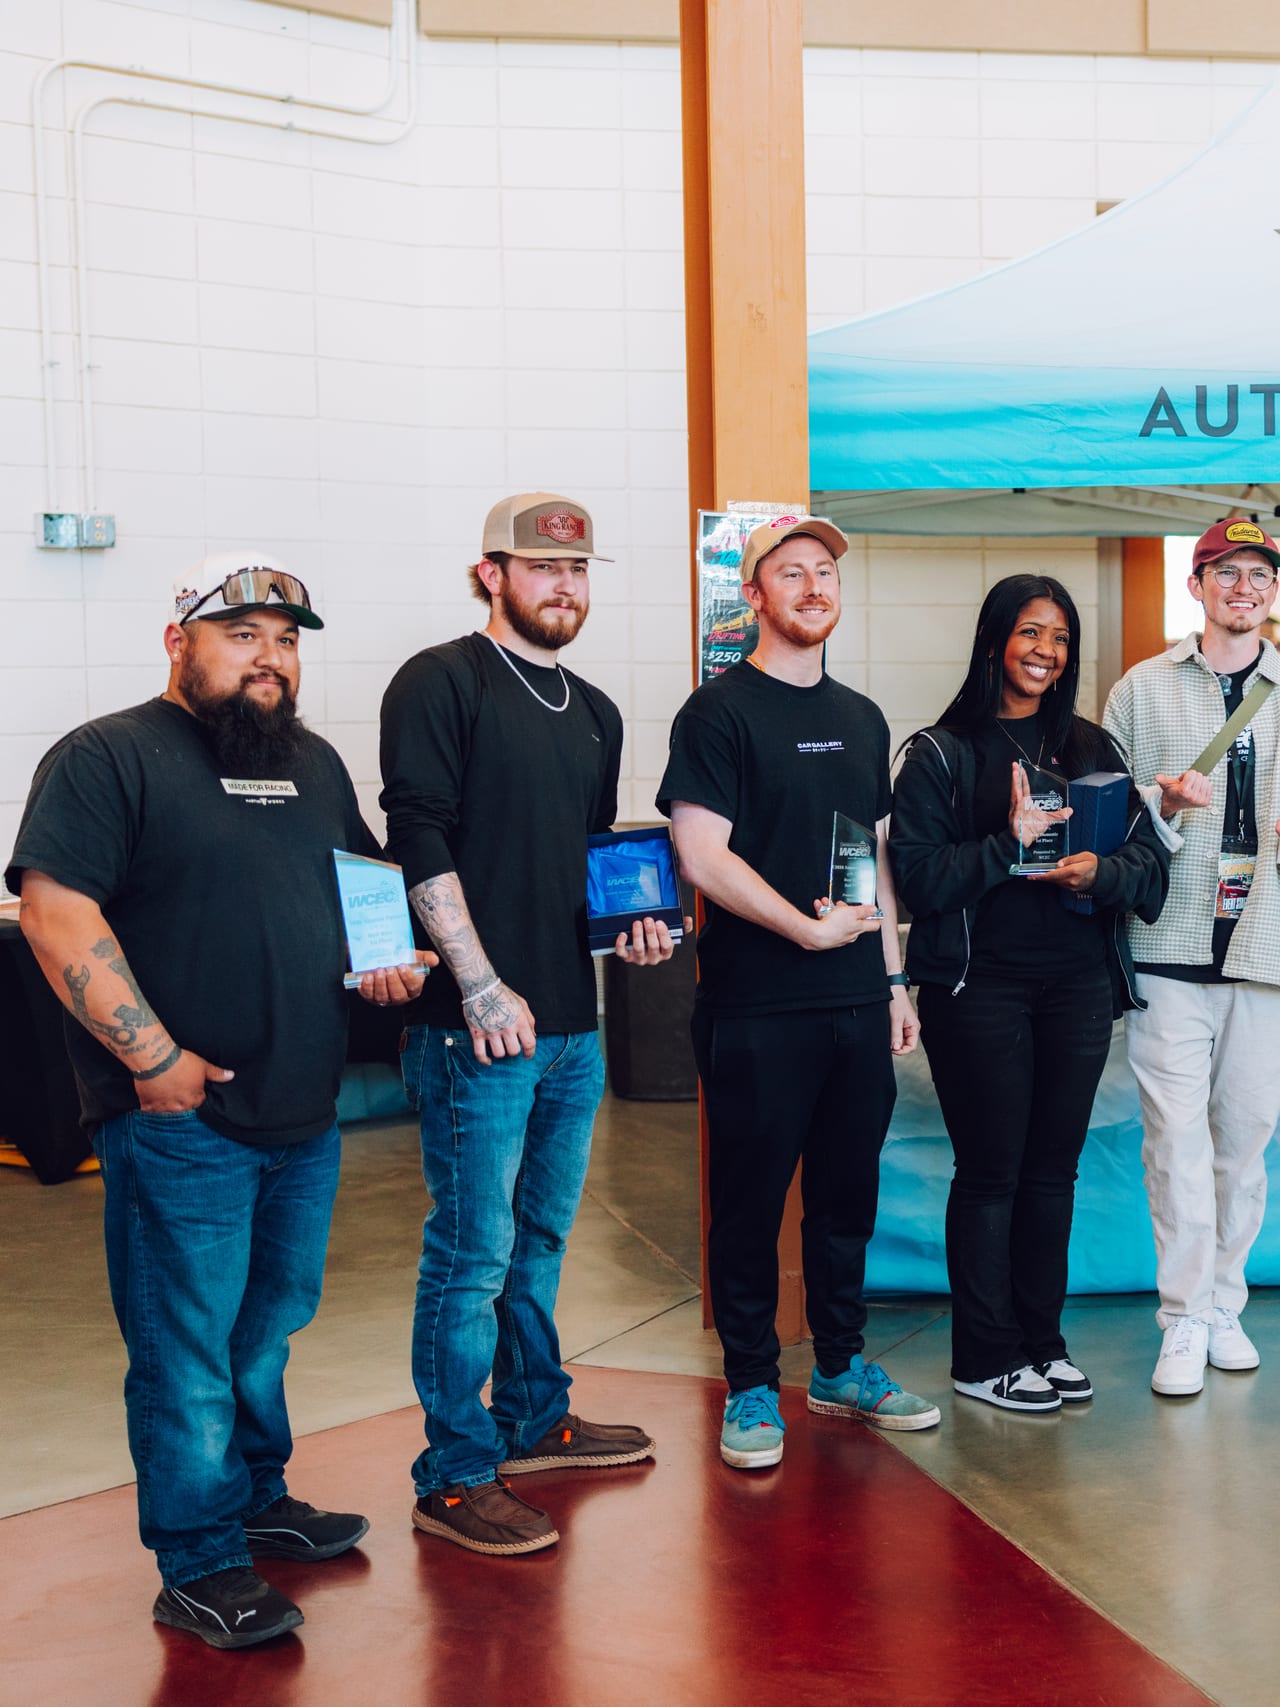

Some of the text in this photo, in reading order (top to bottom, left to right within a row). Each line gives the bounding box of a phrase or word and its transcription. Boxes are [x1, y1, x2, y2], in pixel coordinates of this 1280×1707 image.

[544, 520, 561, 530] KING
[708, 631, 746, 642] DRIFTING
[707, 651, 742, 663] $250
[228, 783, 293, 792] MADE FOR RACING
[1024, 799, 1060, 811] WCEC
[839, 846, 868, 857] WCEC
[348, 891, 395, 909] WCEC
